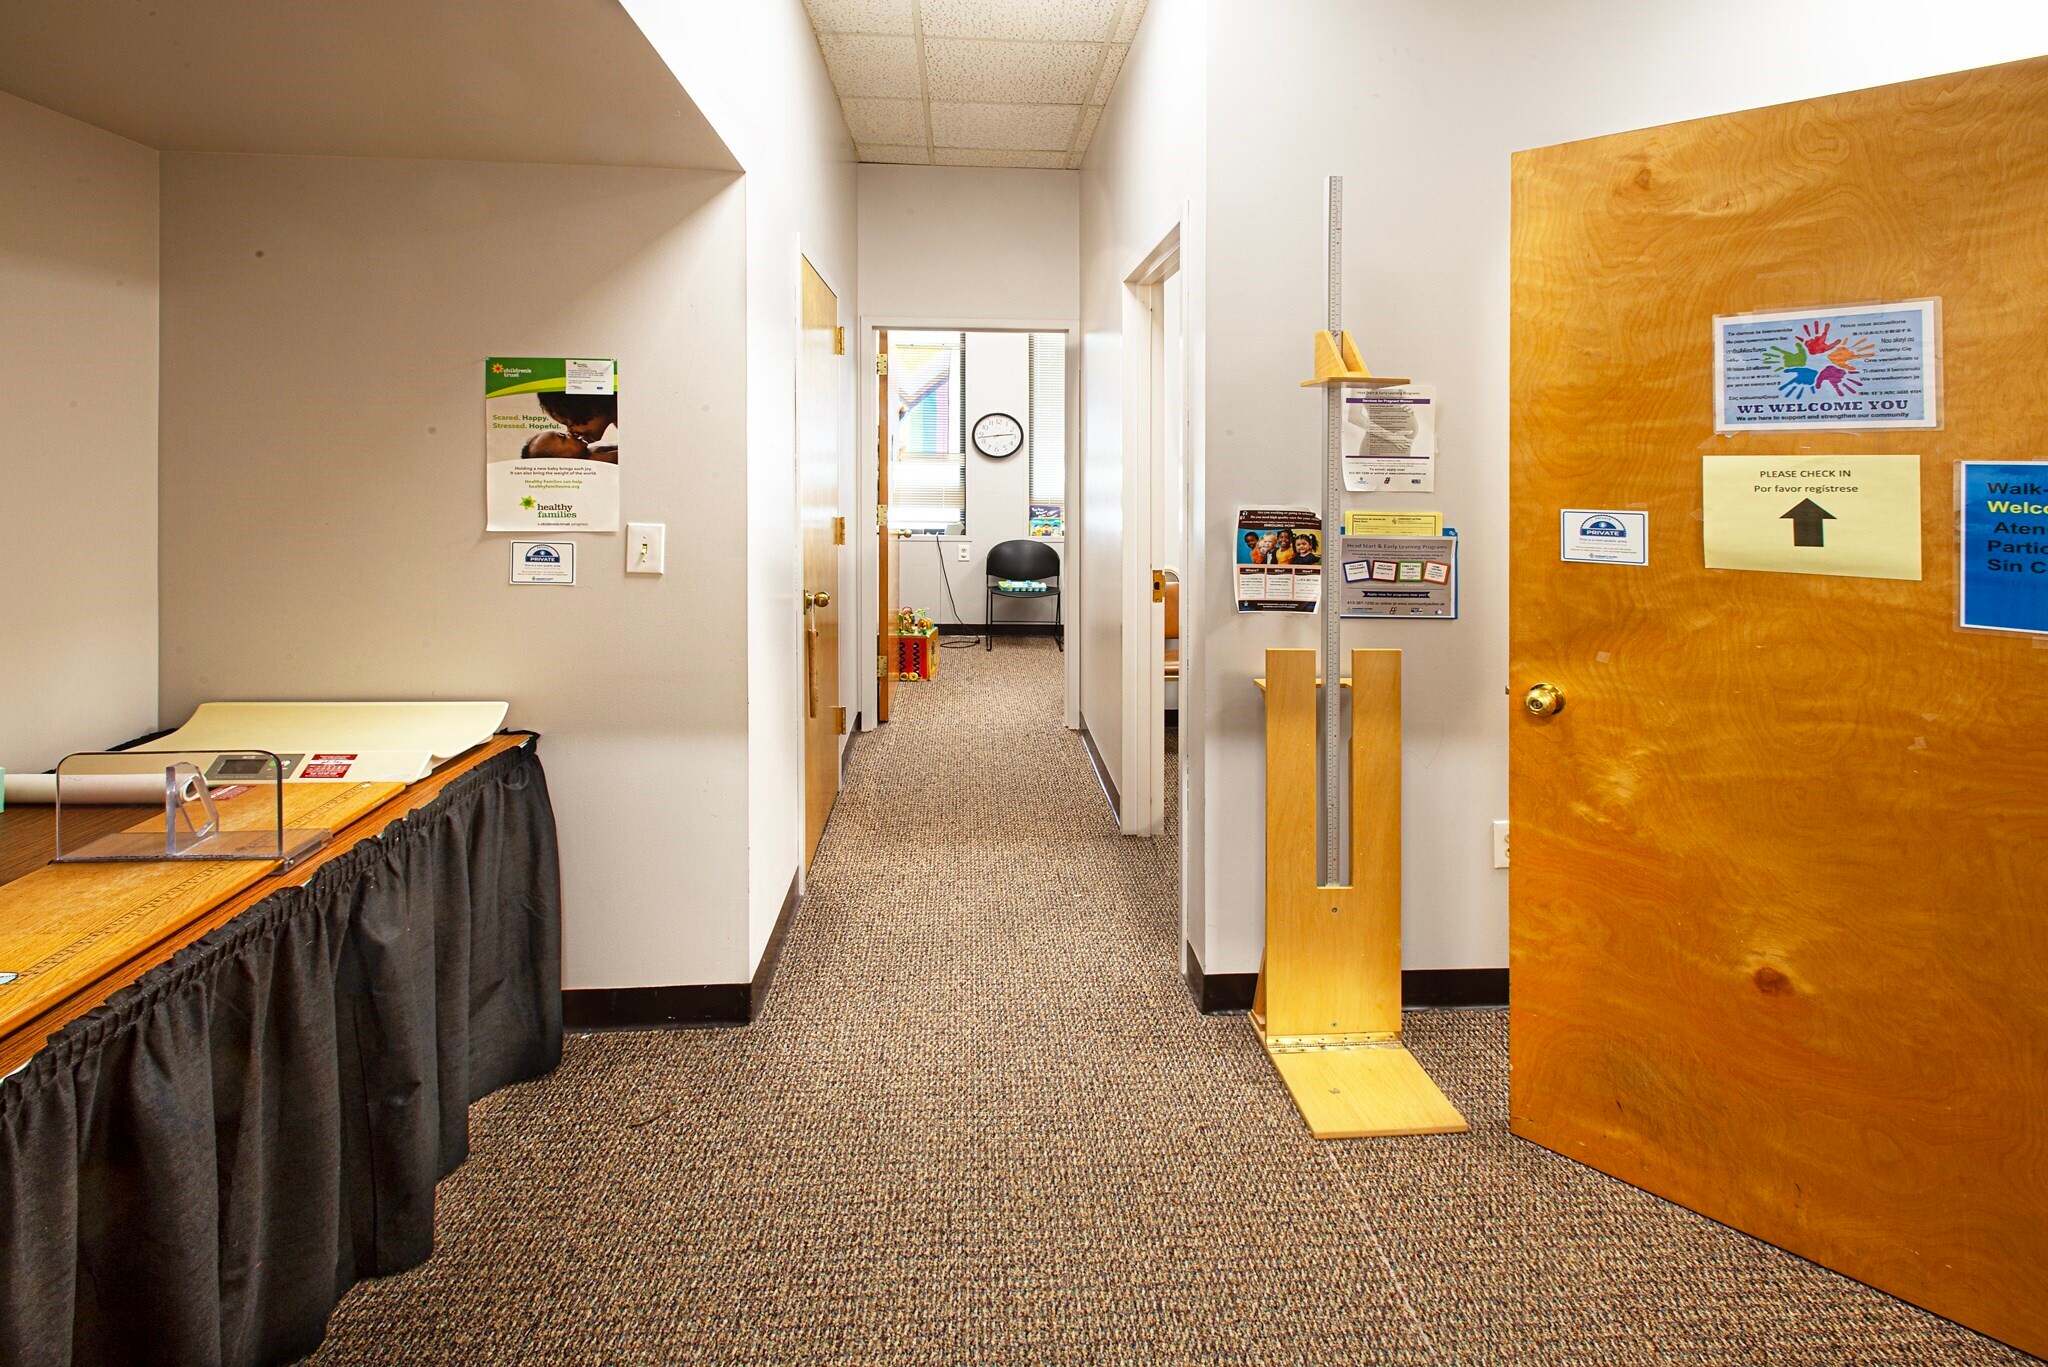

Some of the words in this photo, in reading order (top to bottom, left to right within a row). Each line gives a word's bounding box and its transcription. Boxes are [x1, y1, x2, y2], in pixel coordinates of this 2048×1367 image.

[1737, 404, 1764, 414] WE
[1768, 402, 1862, 412] WELCOME
[1868, 400, 1908, 410] YOU
[1775, 484, 1802, 492] favor
[538, 504, 572, 512] healthy
[1988, 559, 2022, 572] Sin
